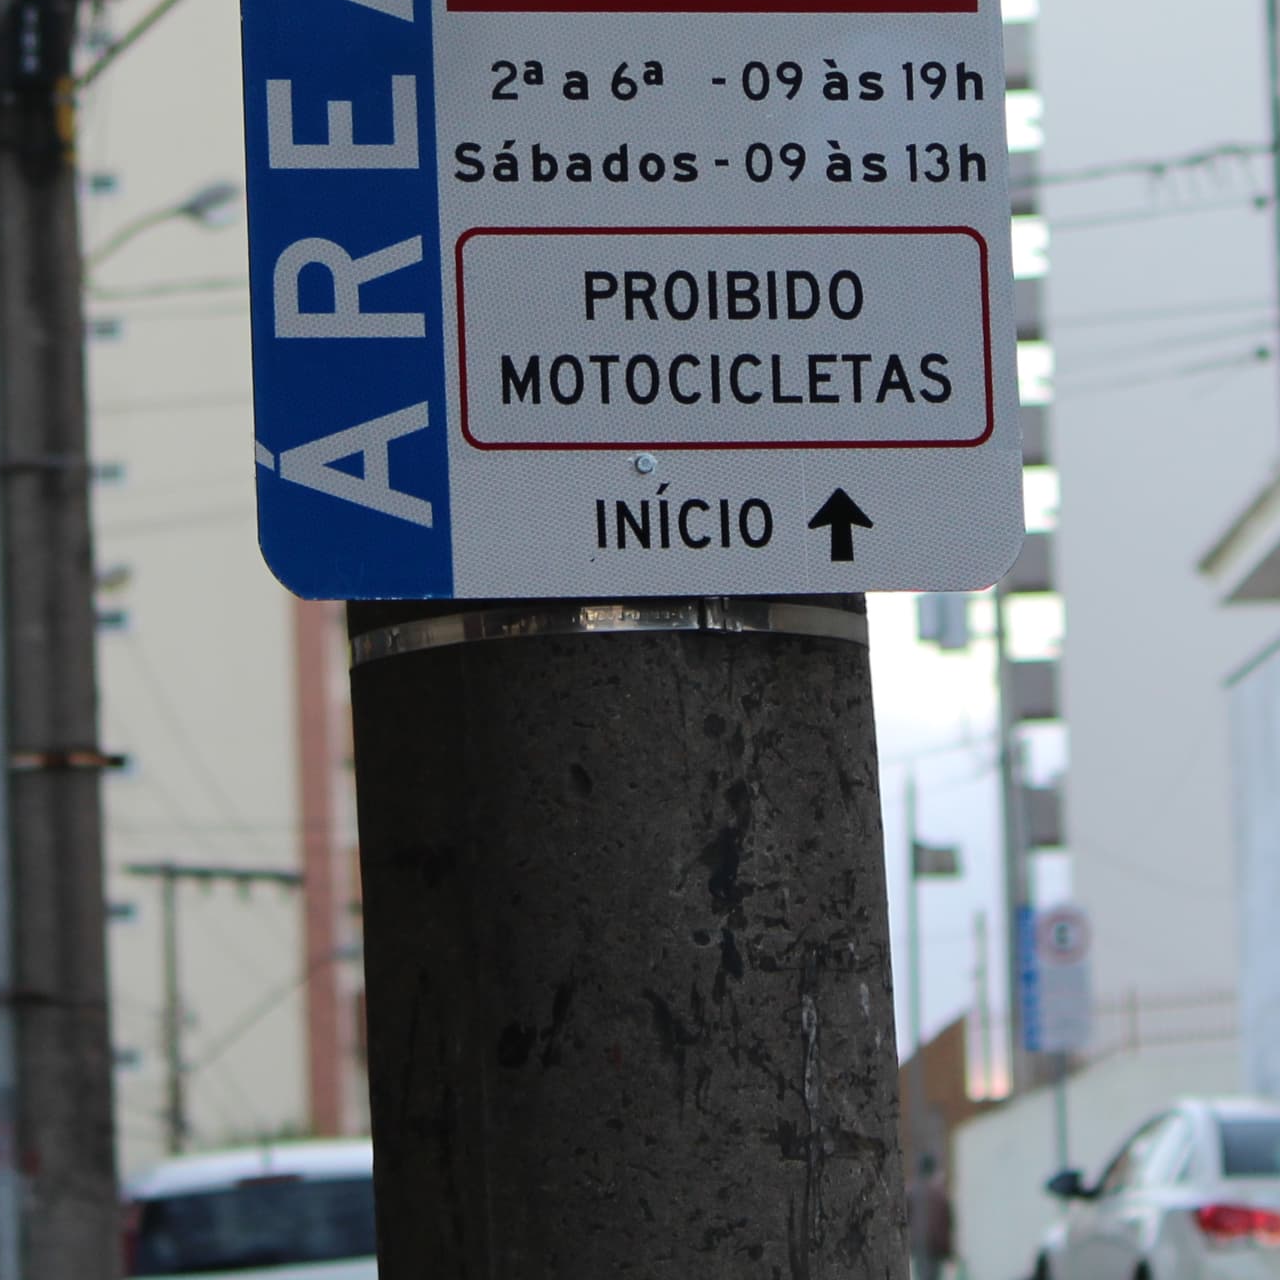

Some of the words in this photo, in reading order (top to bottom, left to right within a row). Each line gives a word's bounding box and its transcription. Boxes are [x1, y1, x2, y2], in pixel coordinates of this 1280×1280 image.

[561, 69, 590, 102] a
[821, 57, 885, 102] às
[901, 60, 985, 102] 19h
[453, 138, 700, 184] Sábados
[744, 141, 807, 184] 09
[825, 138, 889, 184] às
[904, 141, 988, 184] 13h
[583, 268, 865, 323] PROIBIDO
[499, 352, 953, 407] MOTOCICLETAS
[594, 482, 775, 551] INÍCIO
